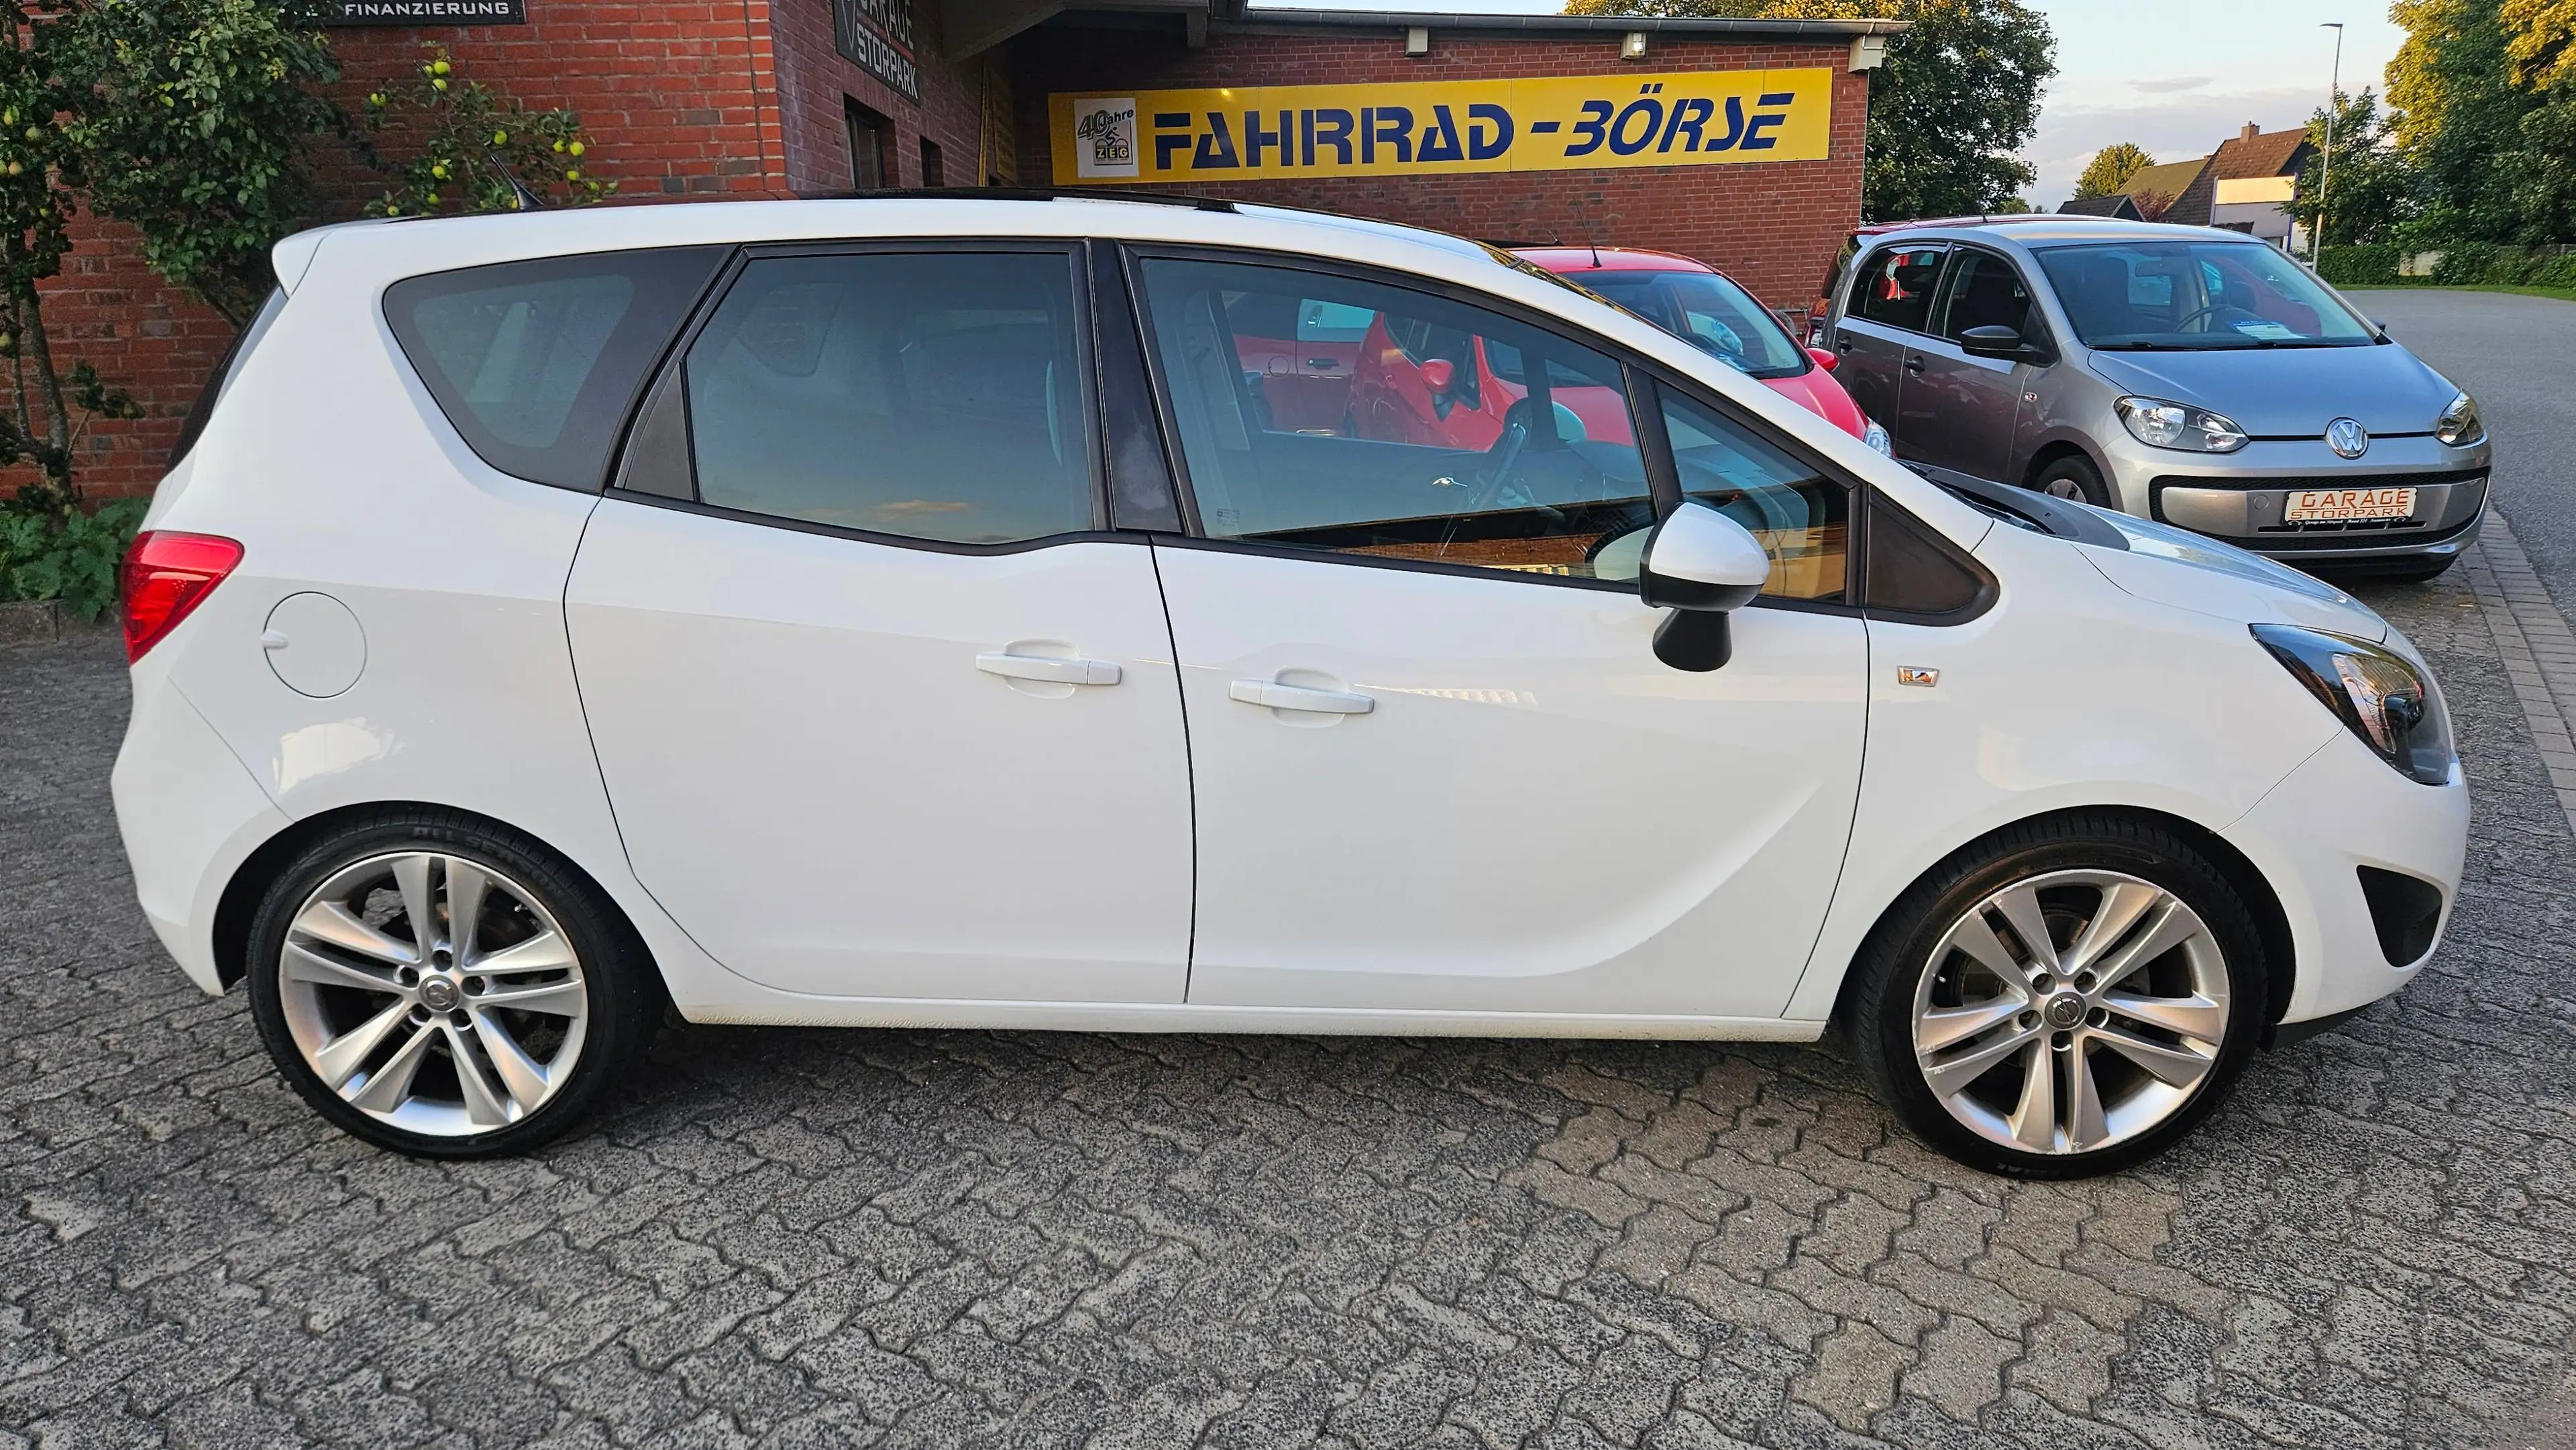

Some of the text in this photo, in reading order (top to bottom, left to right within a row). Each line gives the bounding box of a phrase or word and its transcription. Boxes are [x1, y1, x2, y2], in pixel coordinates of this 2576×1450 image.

[345, 1, 509, 16] FINANZIERUNG
[1077, 109, 1134, 140] 40 Jahre
[1154, 103, 1515, 170] FAHRRAD
[1097, 148, 1128, 158] ZEG
[2301, 490, 2410, 509] GARAGE
[2291, 507, 2408, 520] STÖRPARK
